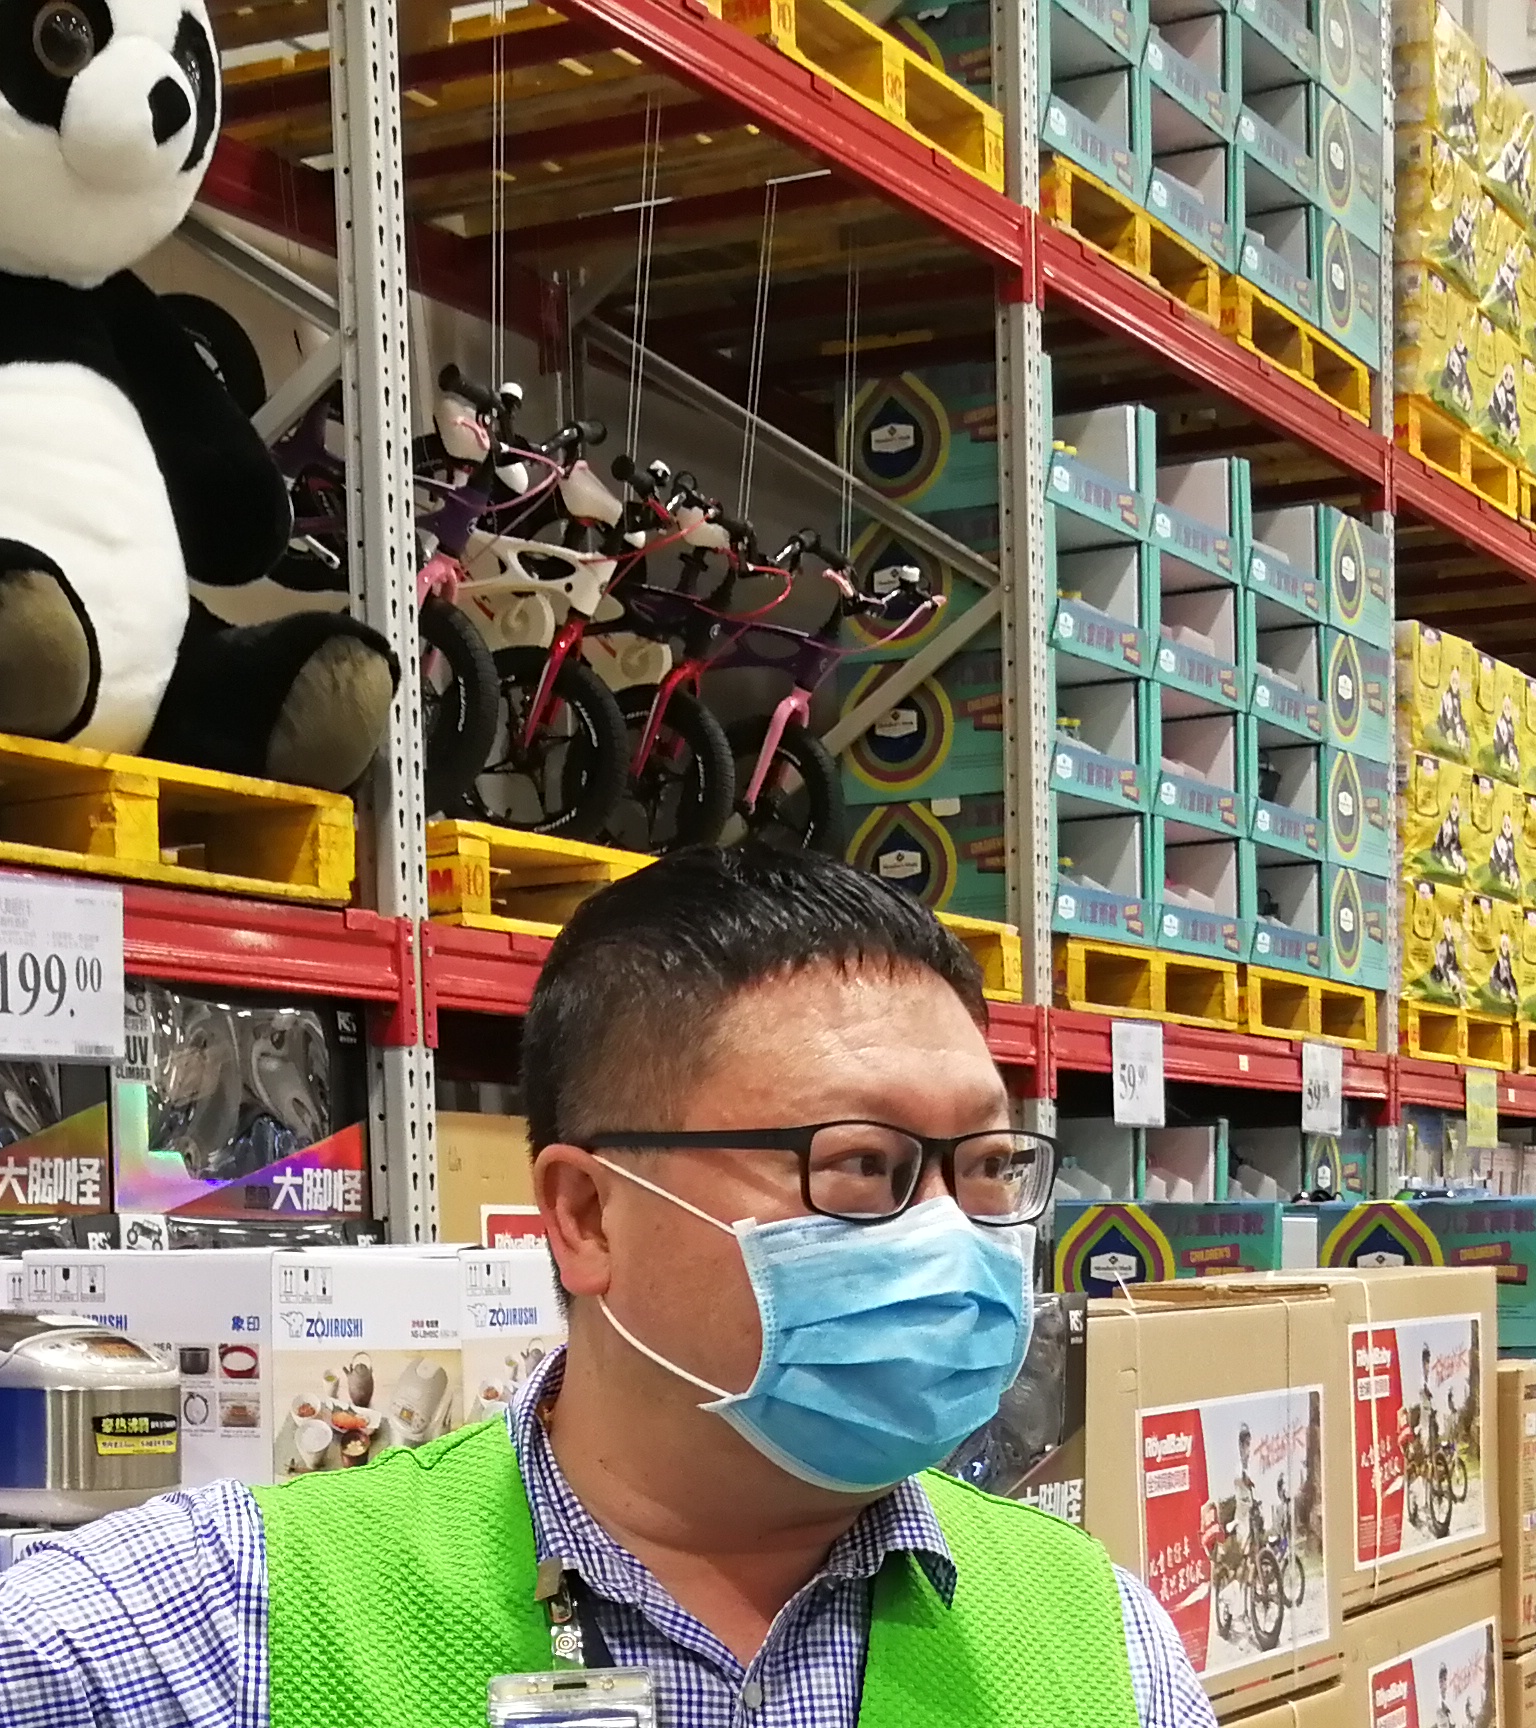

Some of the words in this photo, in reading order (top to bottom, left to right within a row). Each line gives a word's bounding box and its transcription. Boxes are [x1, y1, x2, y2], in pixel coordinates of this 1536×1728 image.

[125, 1035, 149, 1065] UV
[115, 1063, 152, 1081] CLIMBER
[272, 1166, 363, 1213] 大脚怪
[305, 1317, 363, 1339] ZOJIRUSHI
[488, 1305, 538, 1328] ZOJIRUSHI
